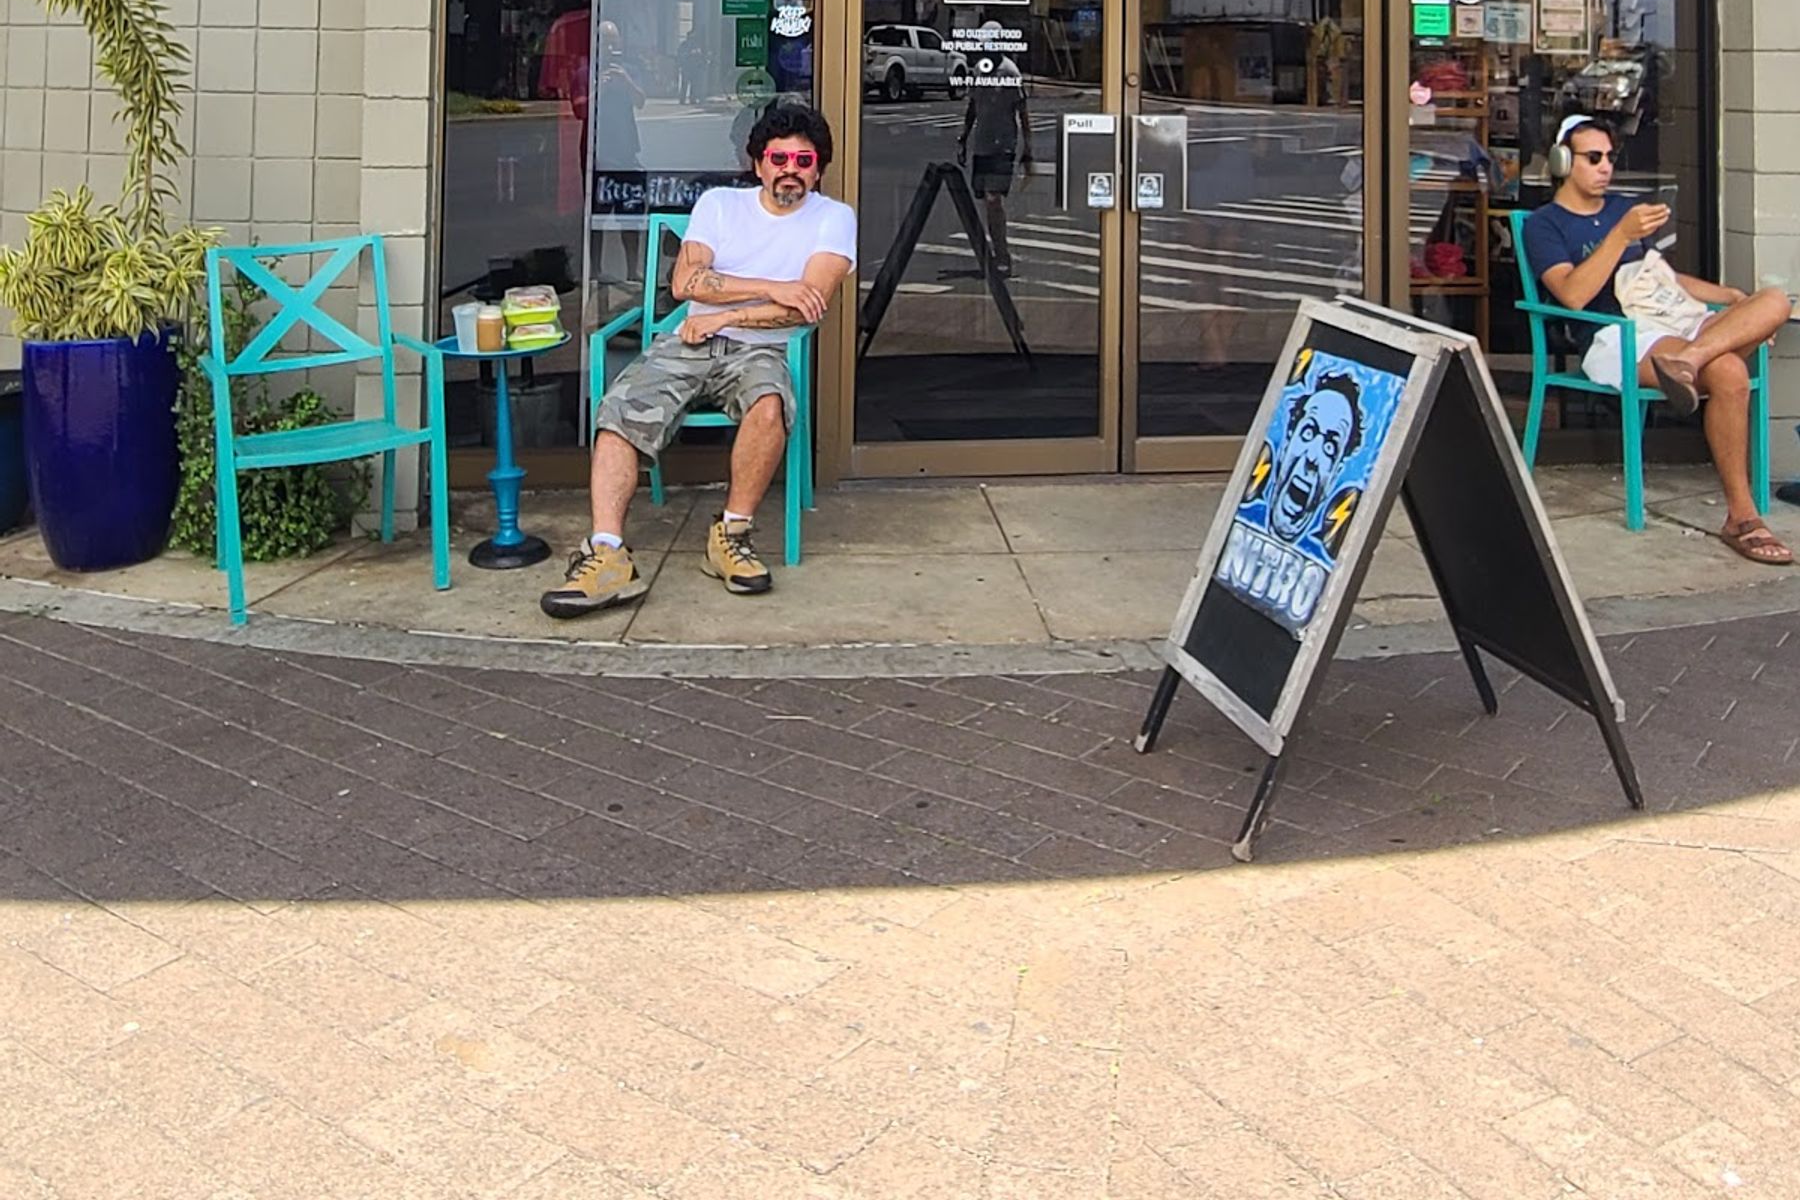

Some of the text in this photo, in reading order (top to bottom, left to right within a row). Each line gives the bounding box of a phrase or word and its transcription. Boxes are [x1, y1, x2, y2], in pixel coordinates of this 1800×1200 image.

[952, 28, 965, 39] NO
[1000, 29, 1022, 39] FOOD
[941, 41, 1028, 52] NO PUBLIC RESTROOM
[974, 76, 1023, 87] AVAILABLE
[1068, 118, 1093, 128] Pull
[1217, 521, 1326, 620] NITRO
